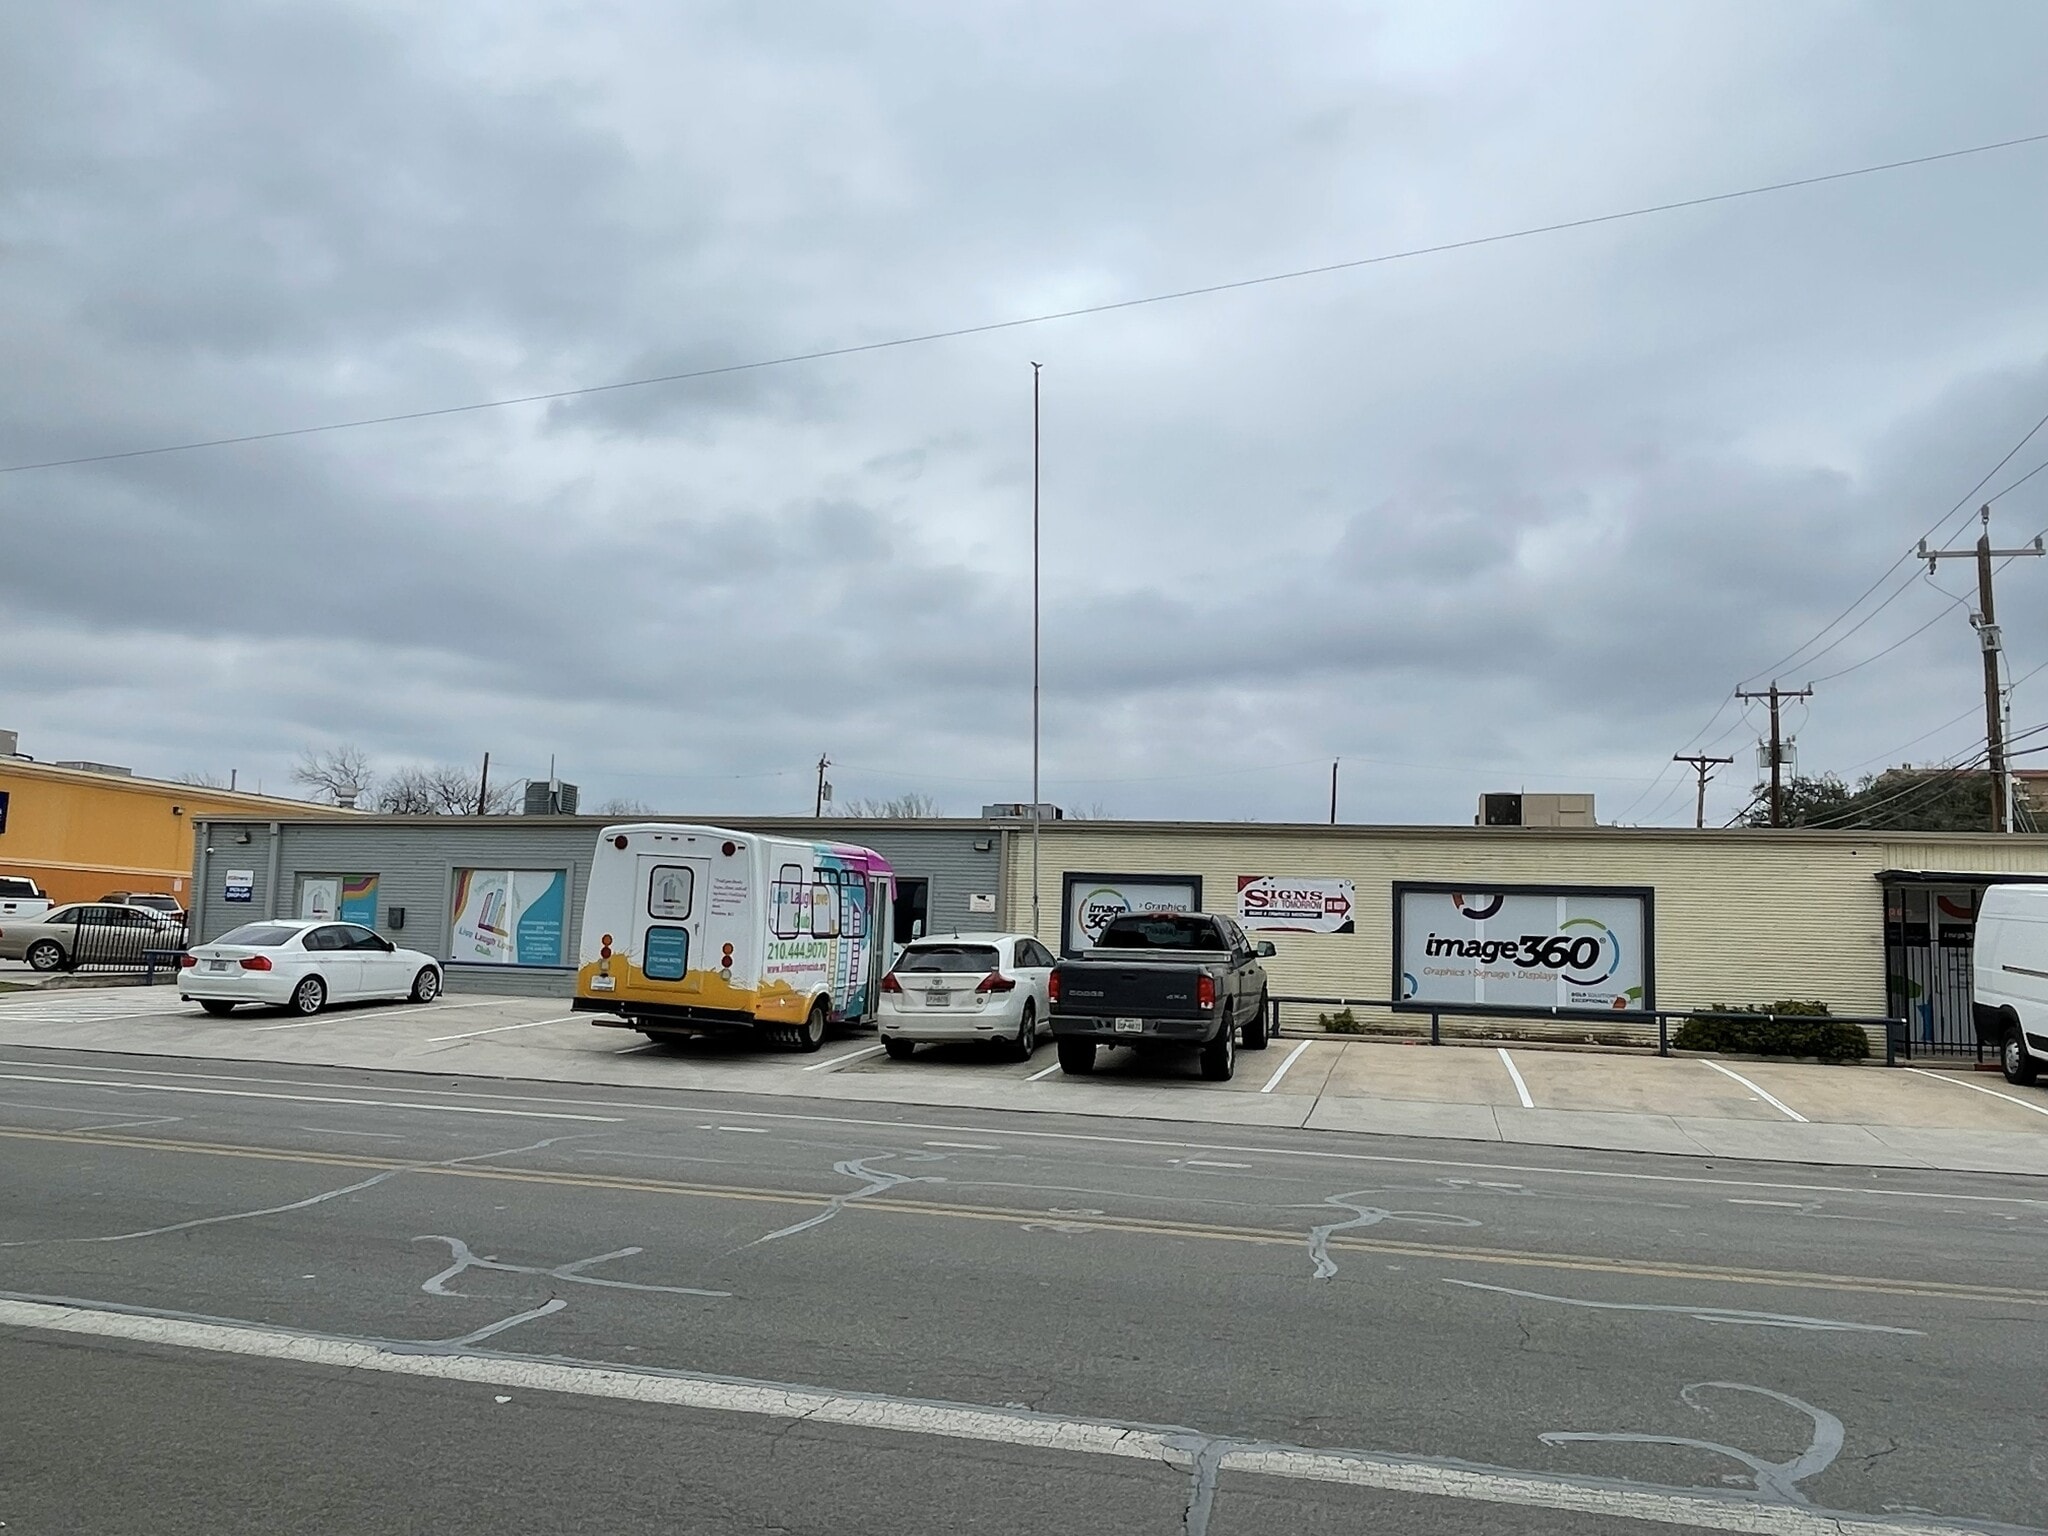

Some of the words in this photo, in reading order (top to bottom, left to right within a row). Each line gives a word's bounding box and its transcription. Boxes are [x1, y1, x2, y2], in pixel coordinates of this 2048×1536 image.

[773, 887, 788, 904] Lve
[1245, 889, 1323, 907] SIGNS
[1282, 900, 1322, 909] TOMORROW
[793, 912, 810, 929] Cub
[1425, 933, 1600, 969] image360
[1423, 967, 1465, 977] Graphics
[1473, 969, 1510, 980] Signage
[1517, 971, 1558, 982] Displays
